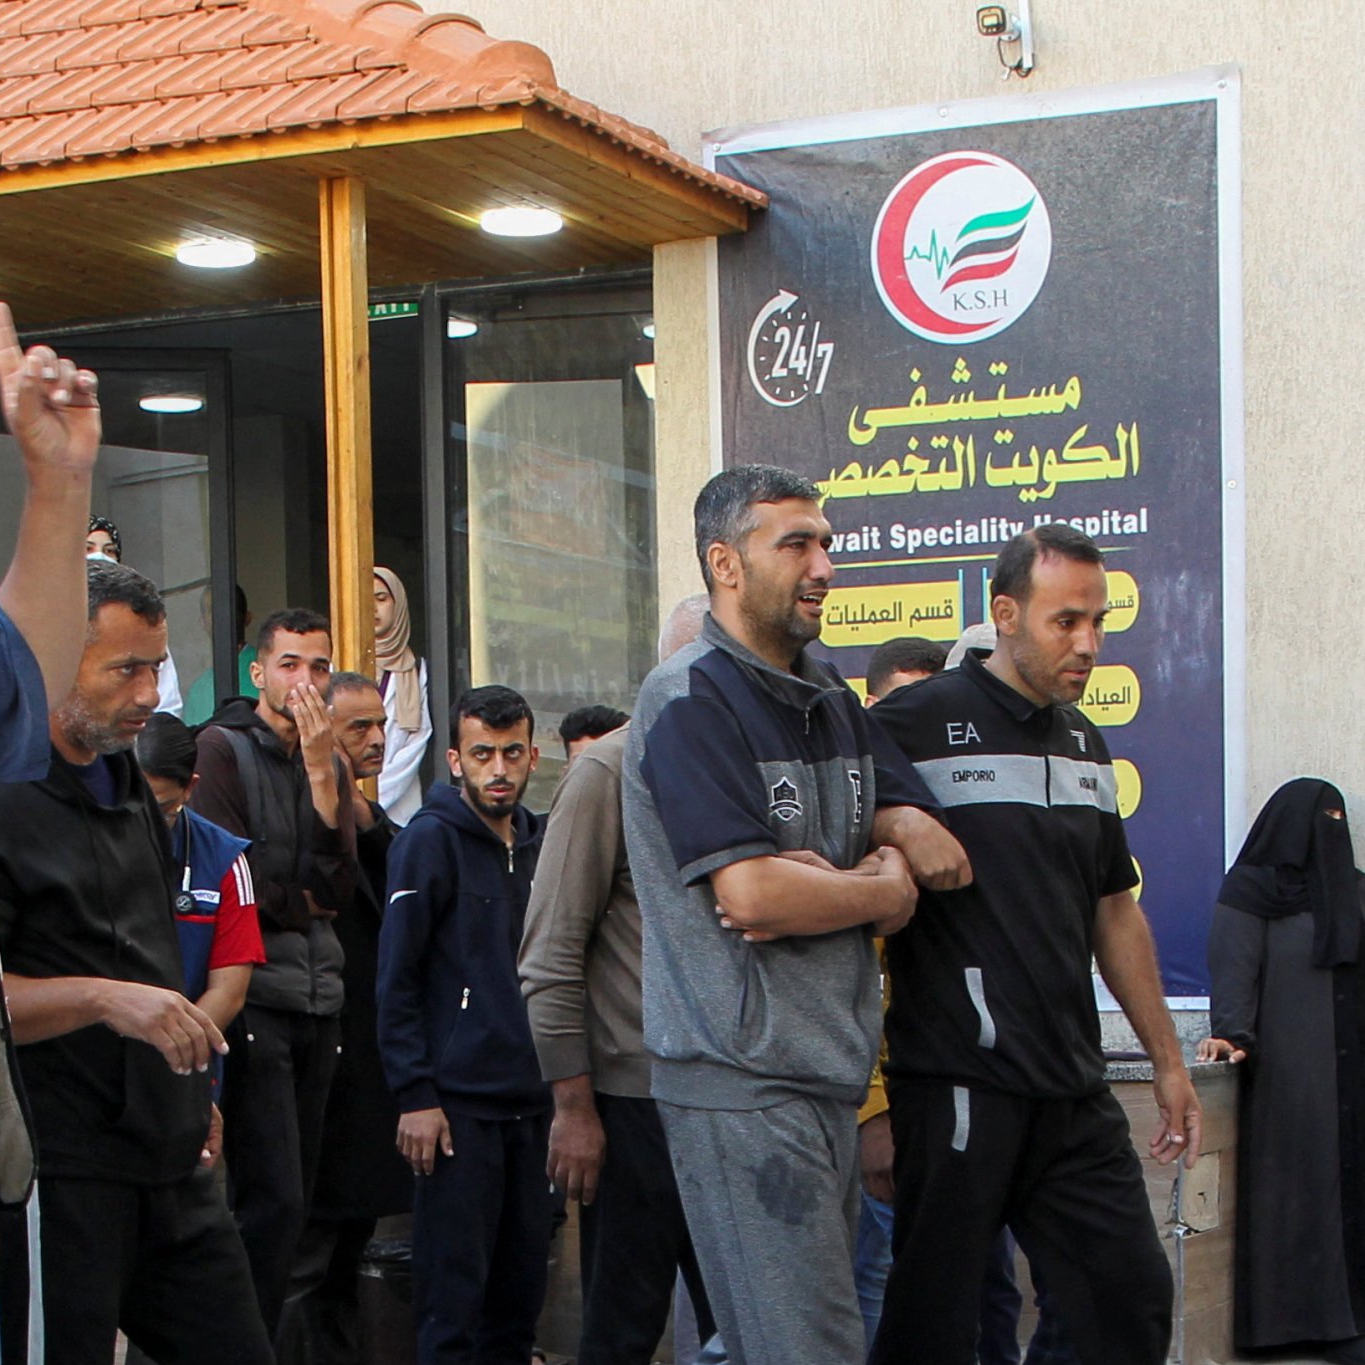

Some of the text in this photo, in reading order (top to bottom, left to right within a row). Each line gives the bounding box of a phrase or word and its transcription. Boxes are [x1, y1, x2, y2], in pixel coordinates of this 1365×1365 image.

[952, 289, 1008, 311] K.S.H
[771, 321, 834, 395] 24/7
[848, 357, 1082, 445] مستشفى
[985, 421, 1140, 503] الكويت
[827, 526, 881, 553] wait
[890, 517, 1024, 554] Speciality
[826, 599, 954, 631] قسم العمليات
[1076, 685, 1131, 711] العيادا
[946, 722, 982, 745] EA
[952, 770, 996, 783] EMPORIO
